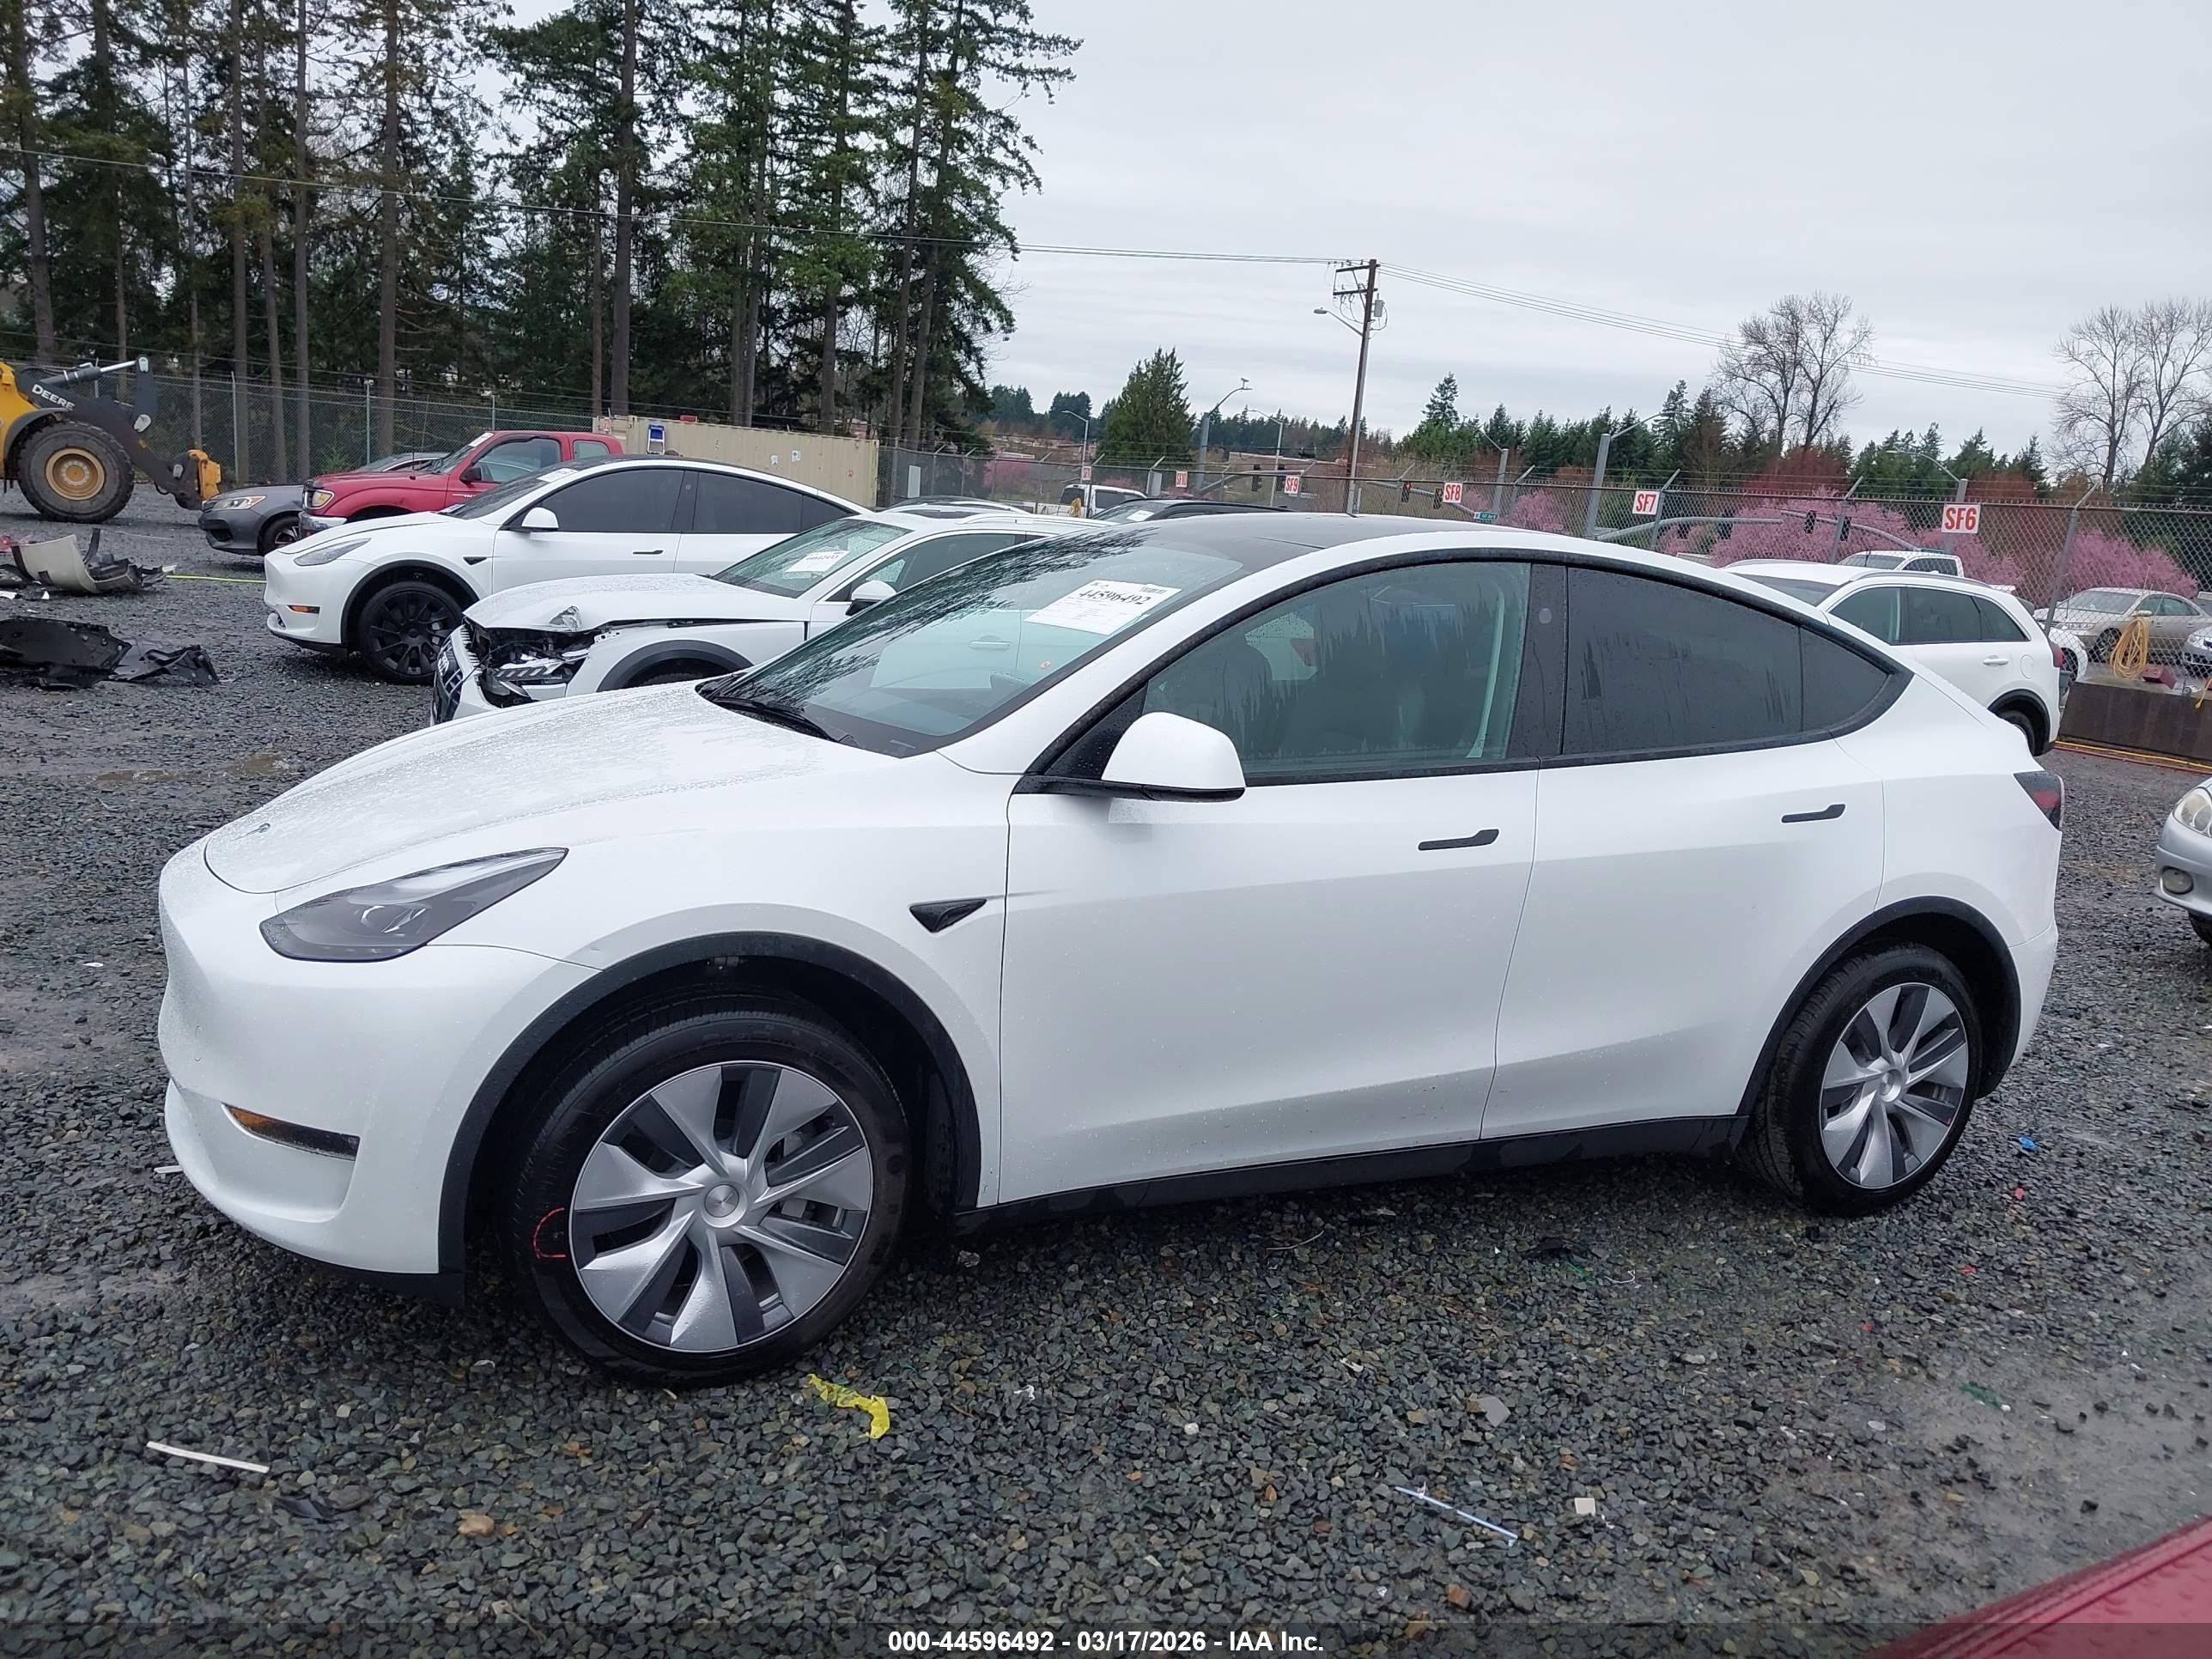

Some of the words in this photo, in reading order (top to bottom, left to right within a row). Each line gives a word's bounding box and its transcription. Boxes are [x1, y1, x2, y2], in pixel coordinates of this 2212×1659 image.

[32, 384, 76, 411] DEERE
[1286, 477, 1298, 492] SF9
[1445, 484, 1461, 501] SF8
[1636, 494, 1657, 512] SF7
[1945, 507, 1977, 530] SF6
